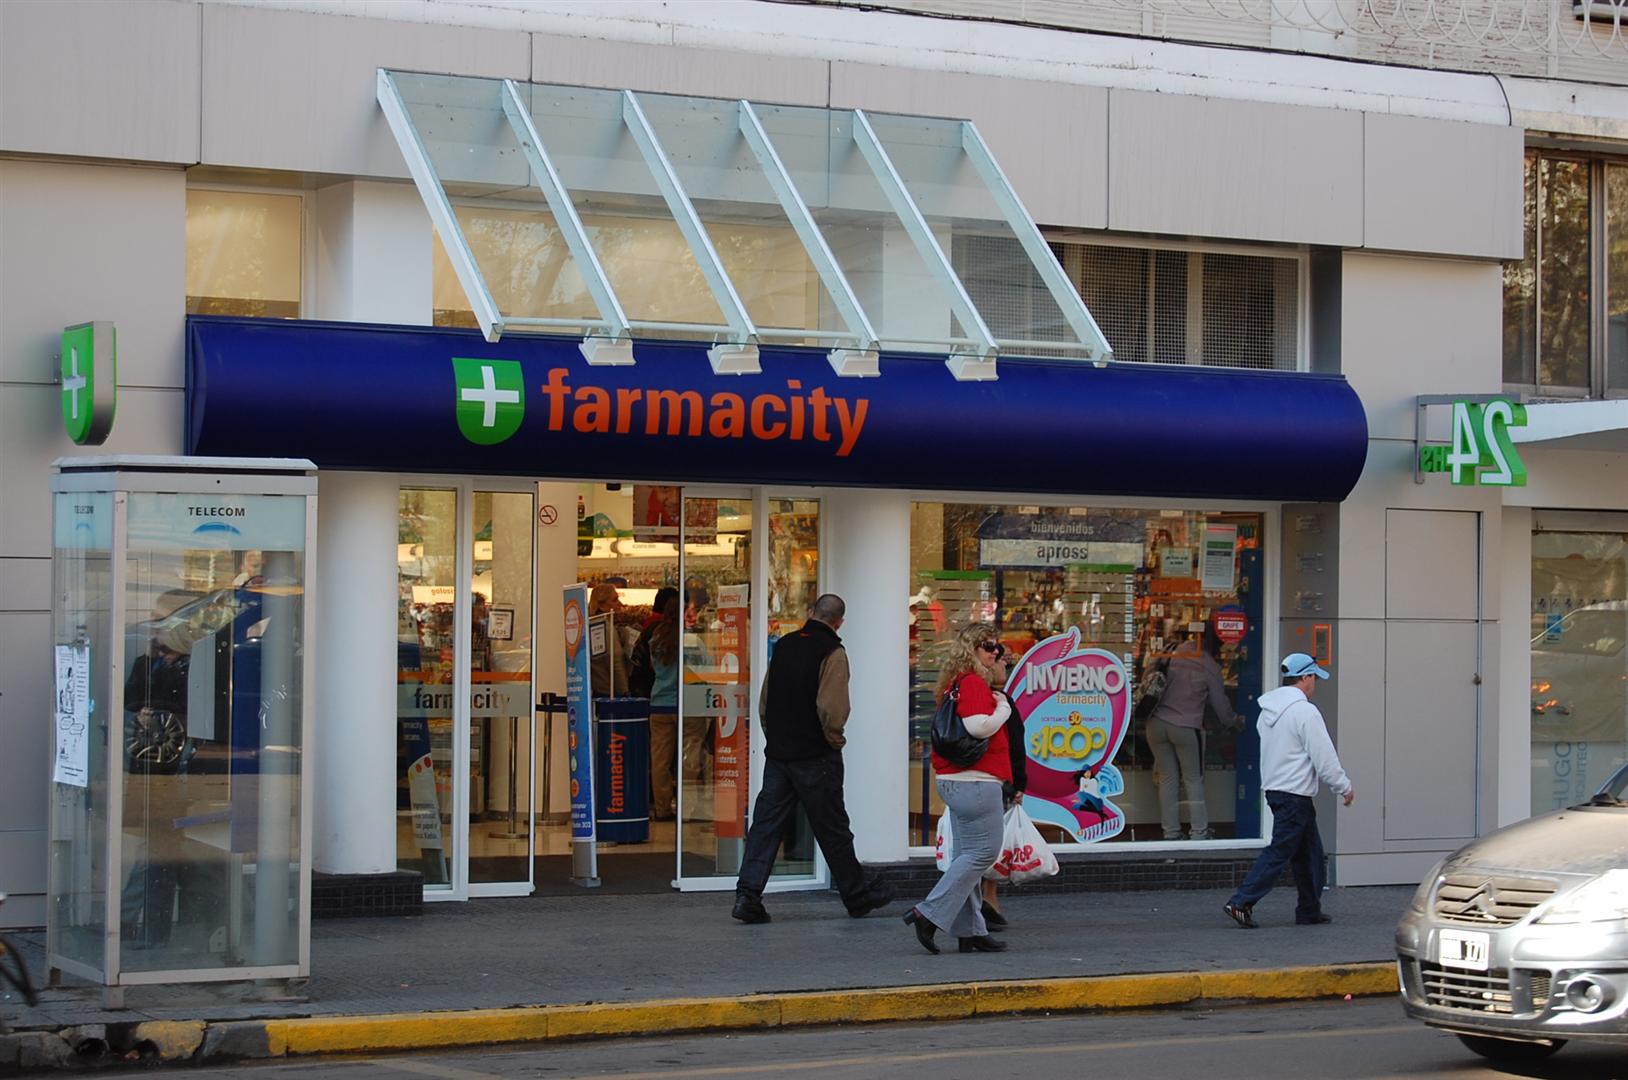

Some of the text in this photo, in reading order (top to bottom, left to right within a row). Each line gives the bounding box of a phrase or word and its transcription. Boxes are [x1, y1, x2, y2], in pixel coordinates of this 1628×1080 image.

[541, 367, 869, 457] farmacity
[188, 506, 246, 517] TELECOM
[1031, 520, 1094, 536] bienvenidos
[1037, 544, 1088, 563] apross
[1026, 662, 1126, 696] INVIERNO
[1056, 692, 1107, 706] farmacity
[1031, 725, 1107, 761] $1000
[607, 731, 628, 814] farmacity
